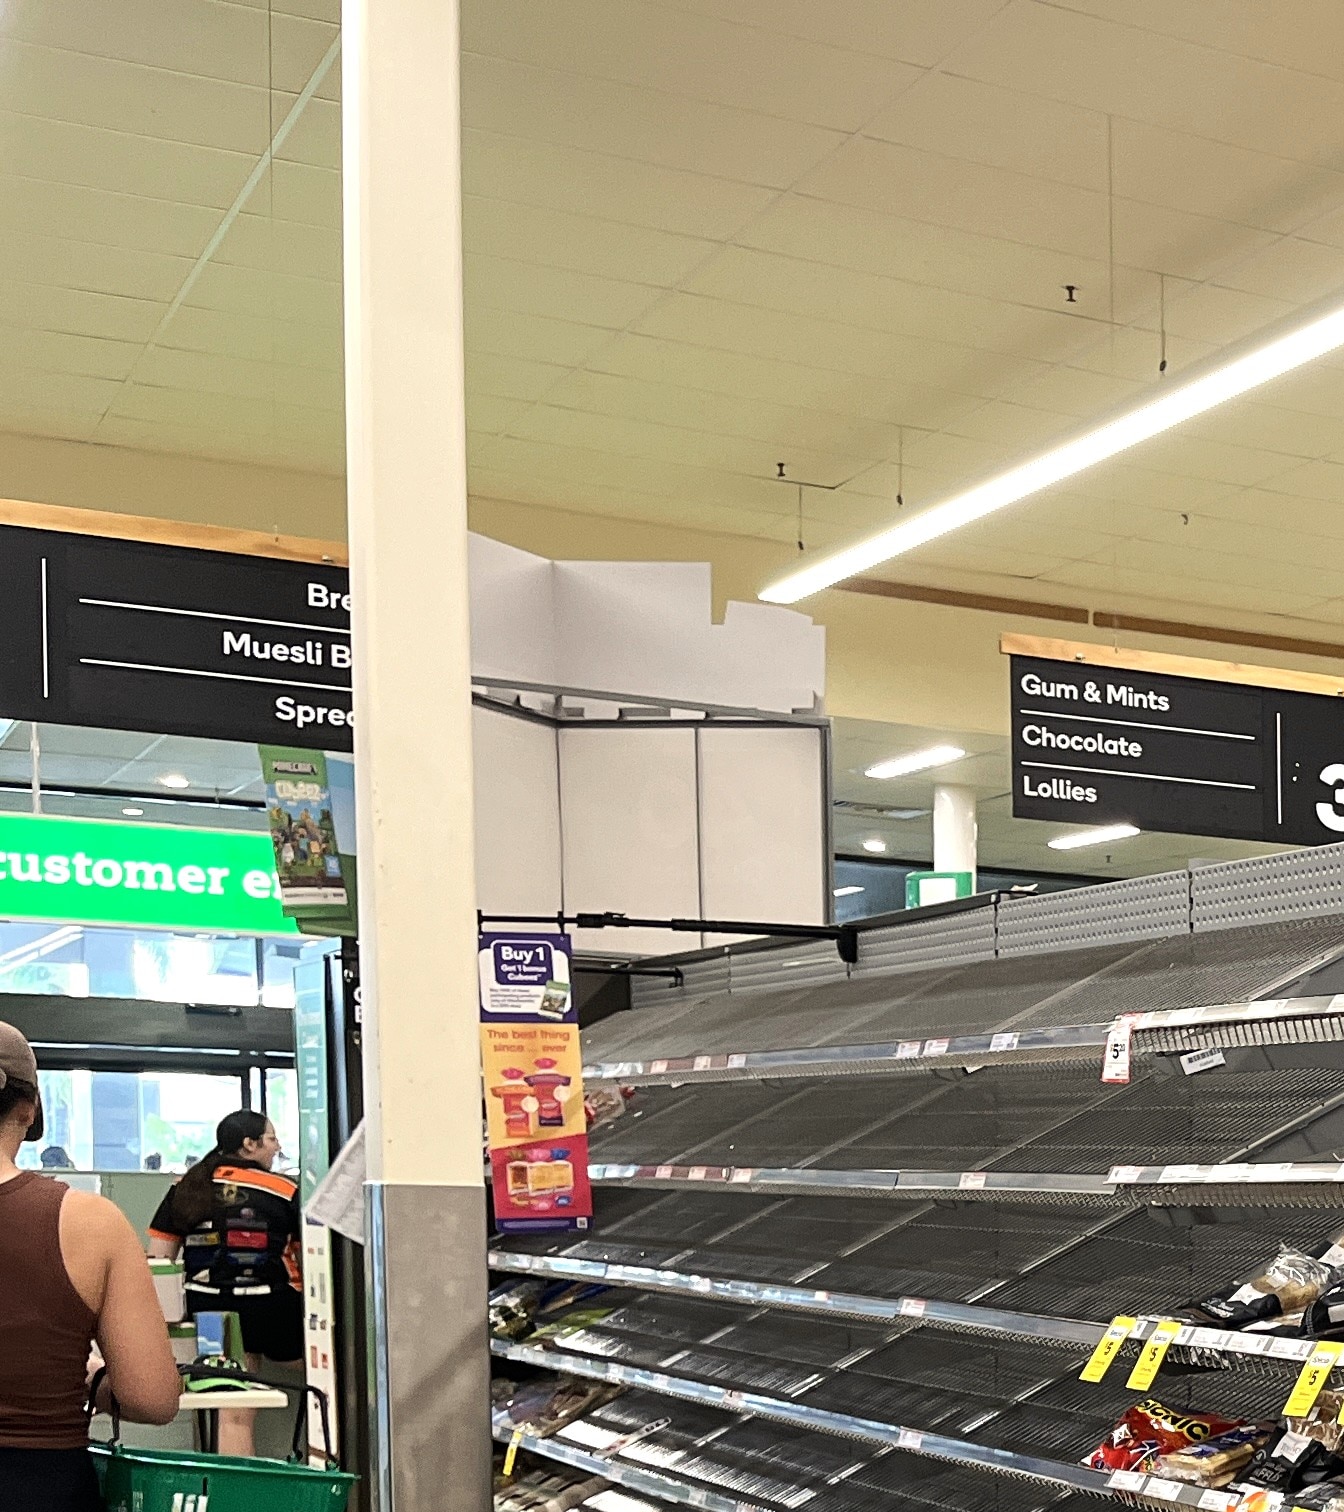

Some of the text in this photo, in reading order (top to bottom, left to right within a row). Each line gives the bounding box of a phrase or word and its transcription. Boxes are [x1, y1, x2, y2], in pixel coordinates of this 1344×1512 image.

[222, 631, 323, 666] Muesli
[1020, 673, 1170, 712] Gum & Mints
[1022, 724, 1143, 758] Chocolate
[1023, 775, 1098, 803] Lollies
[501, 946, 545, 965] Buy 1
[487, 1029, 570, 1042] The best thing
